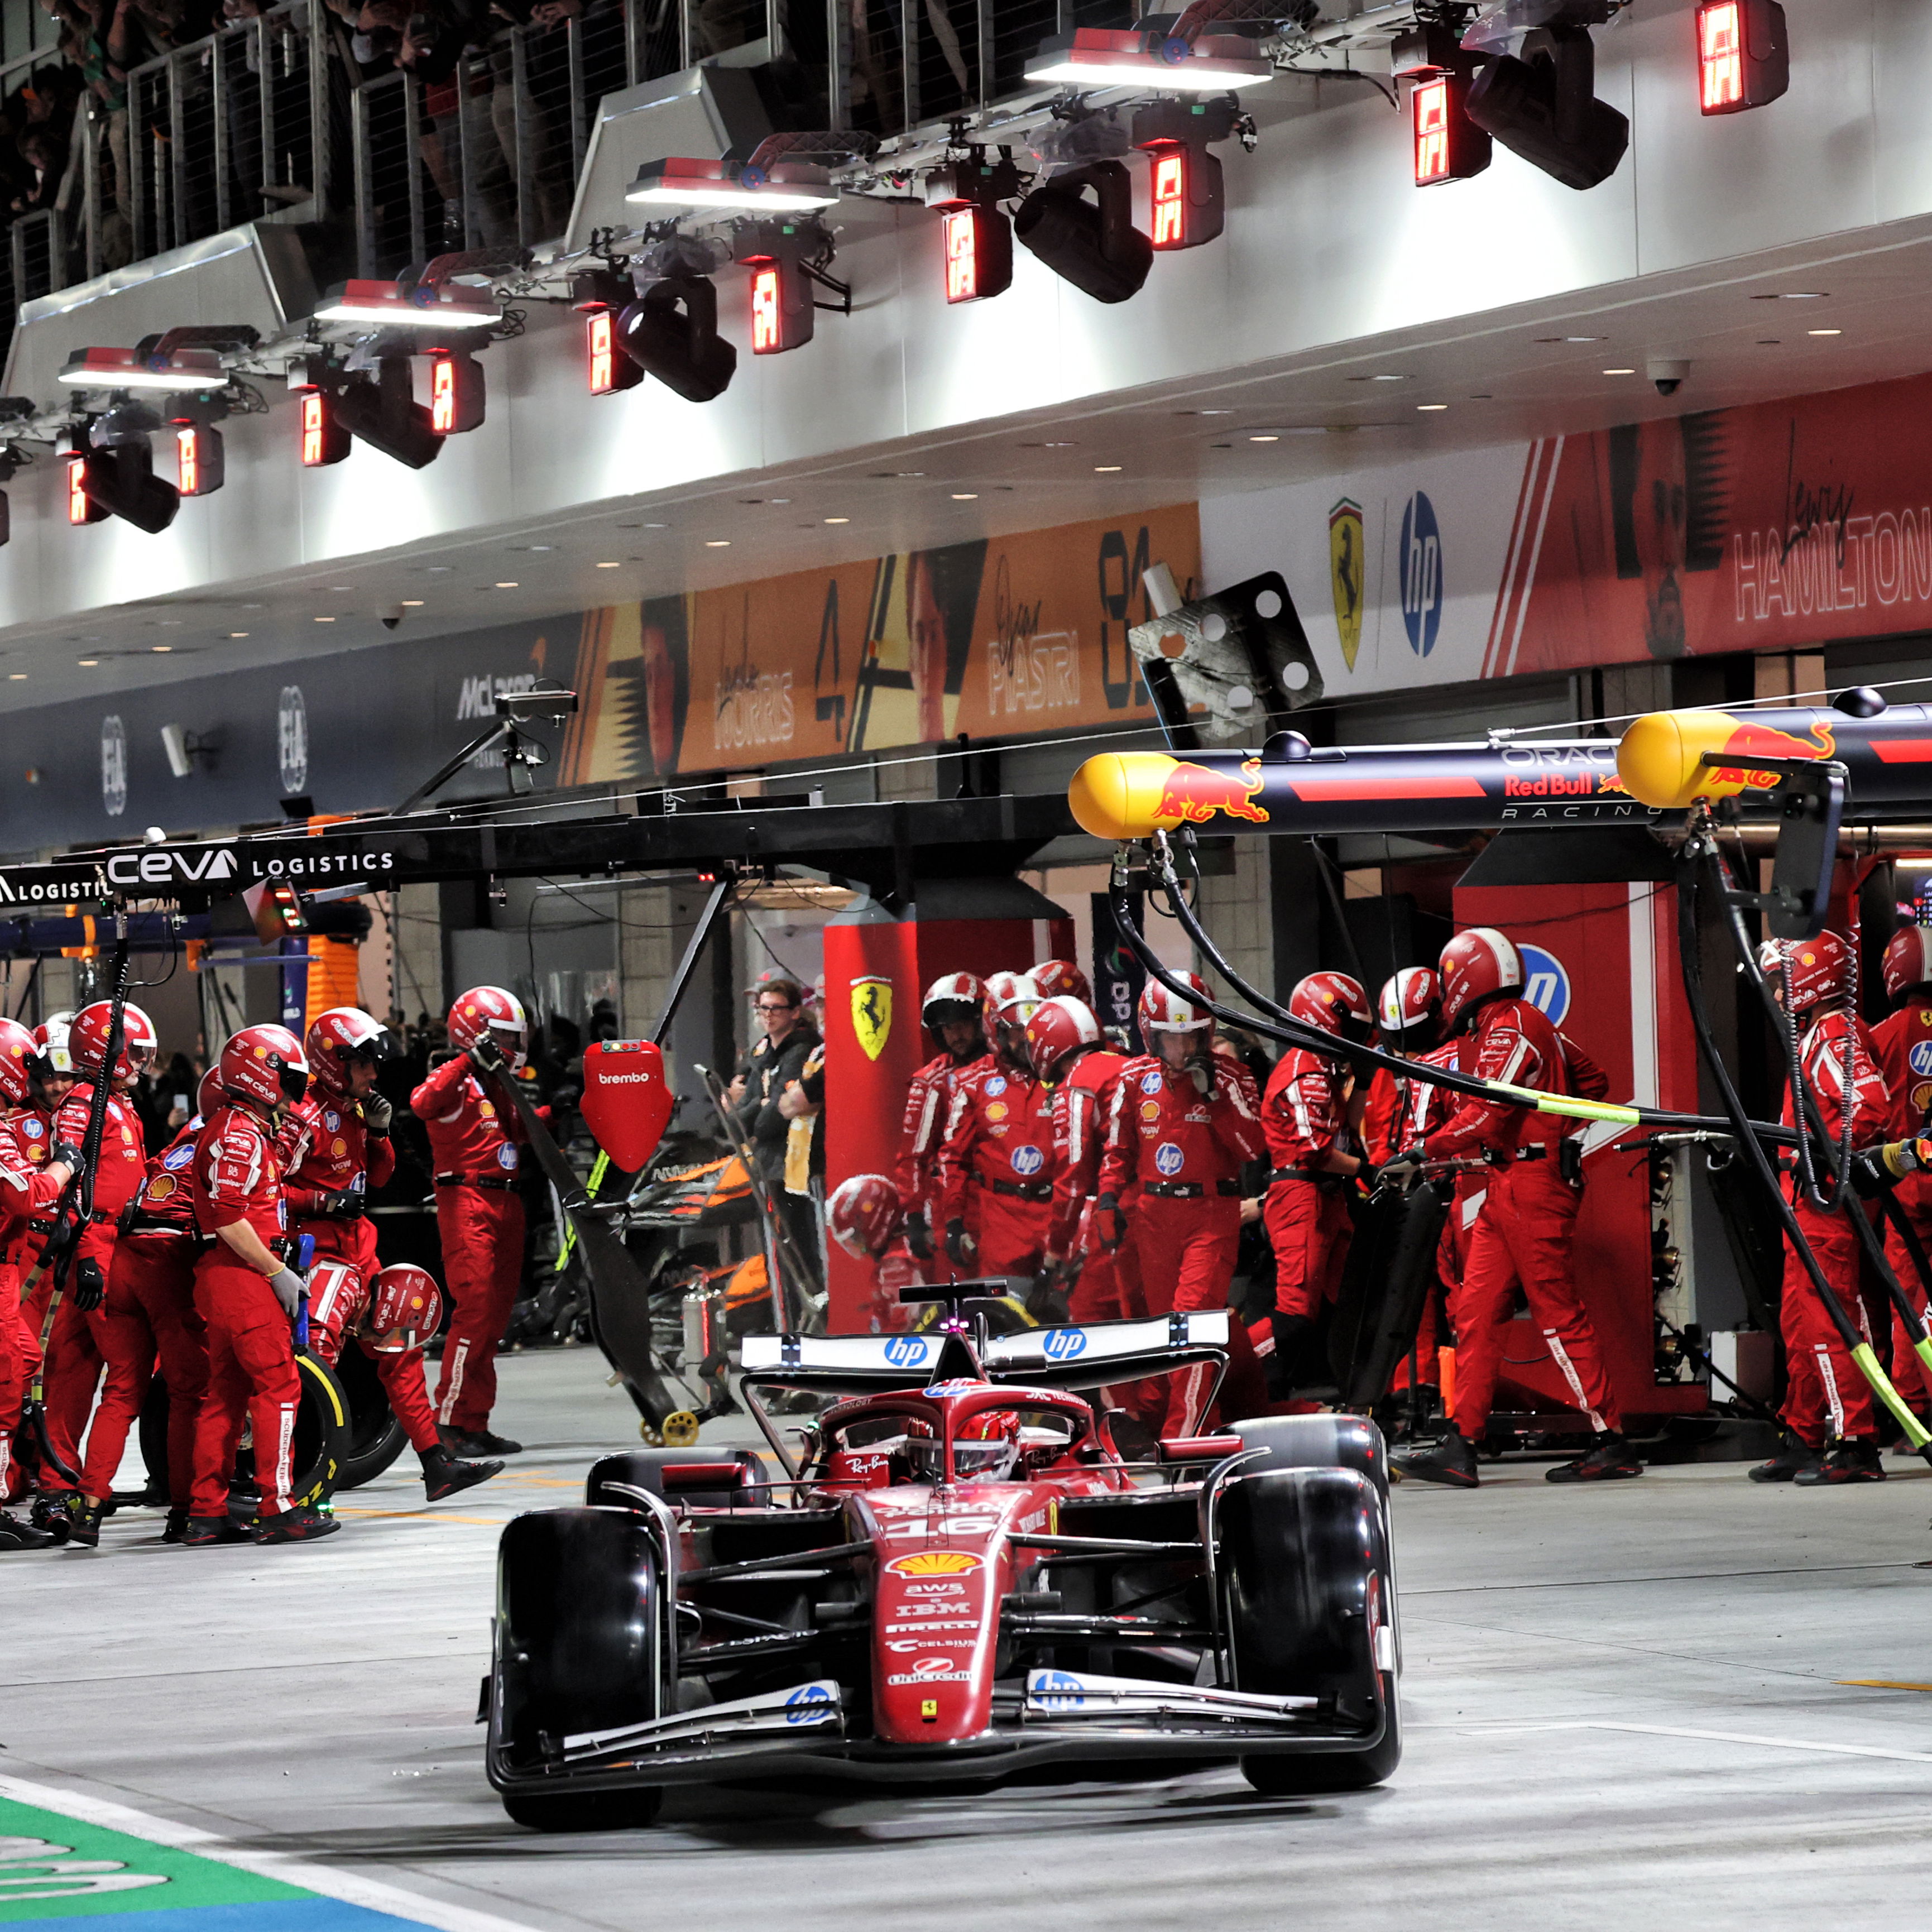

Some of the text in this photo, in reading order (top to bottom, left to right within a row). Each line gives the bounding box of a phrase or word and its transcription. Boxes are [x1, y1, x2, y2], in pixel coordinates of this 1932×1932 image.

[1734, 506, 1932, 621] HAMILTON
[1404, 491, 1440, 656] hp
[989, 631, 1080, 715] PIASTRI
[1502, 746, 1616, 766] ORAC
[1504, 771, 1592, 796] Red Bull
[1502, 804, 1662, 819] RACING
[108, 849, 392, 884] CEVA LOGISTICS
[1485, 1038, 1511, 1047] CEVA
[3, 1077, 23, 1098] CEVA
[598, 1072, 649, 1085] brembo
[252, 1081, 277, 1101] CEVA
[62, 1109, 87, 1119] CEVA
[282, 1118, 299, 1132] EVA
[1453, 1121, 1477, 1137] RICHARD
[224, 1136, 251, 1148] CEVA
[332, 1159, 352, 1171] VGW
[377, 1303, 391, 1329] CEVA
[888, 1337, 924, 1367] hp
[1049, 1330, 1086, 1359] hp
[846, 1457, 889, 1473] Ray-Ban
[886, 1516, 998, 1539] 16
[904, 1583, 964, 1594] aws
[896, 1602, 971, 1617] IBM
[885, 1621, 979, 1633] PIRELLI
[918, 1639, 977, 1648] CELSIUS
[888, 1670, 972, 1685] UniCredit
[1039, 1673, 1081, 1710] hp
[789, 1687, 829, 1723] hp
